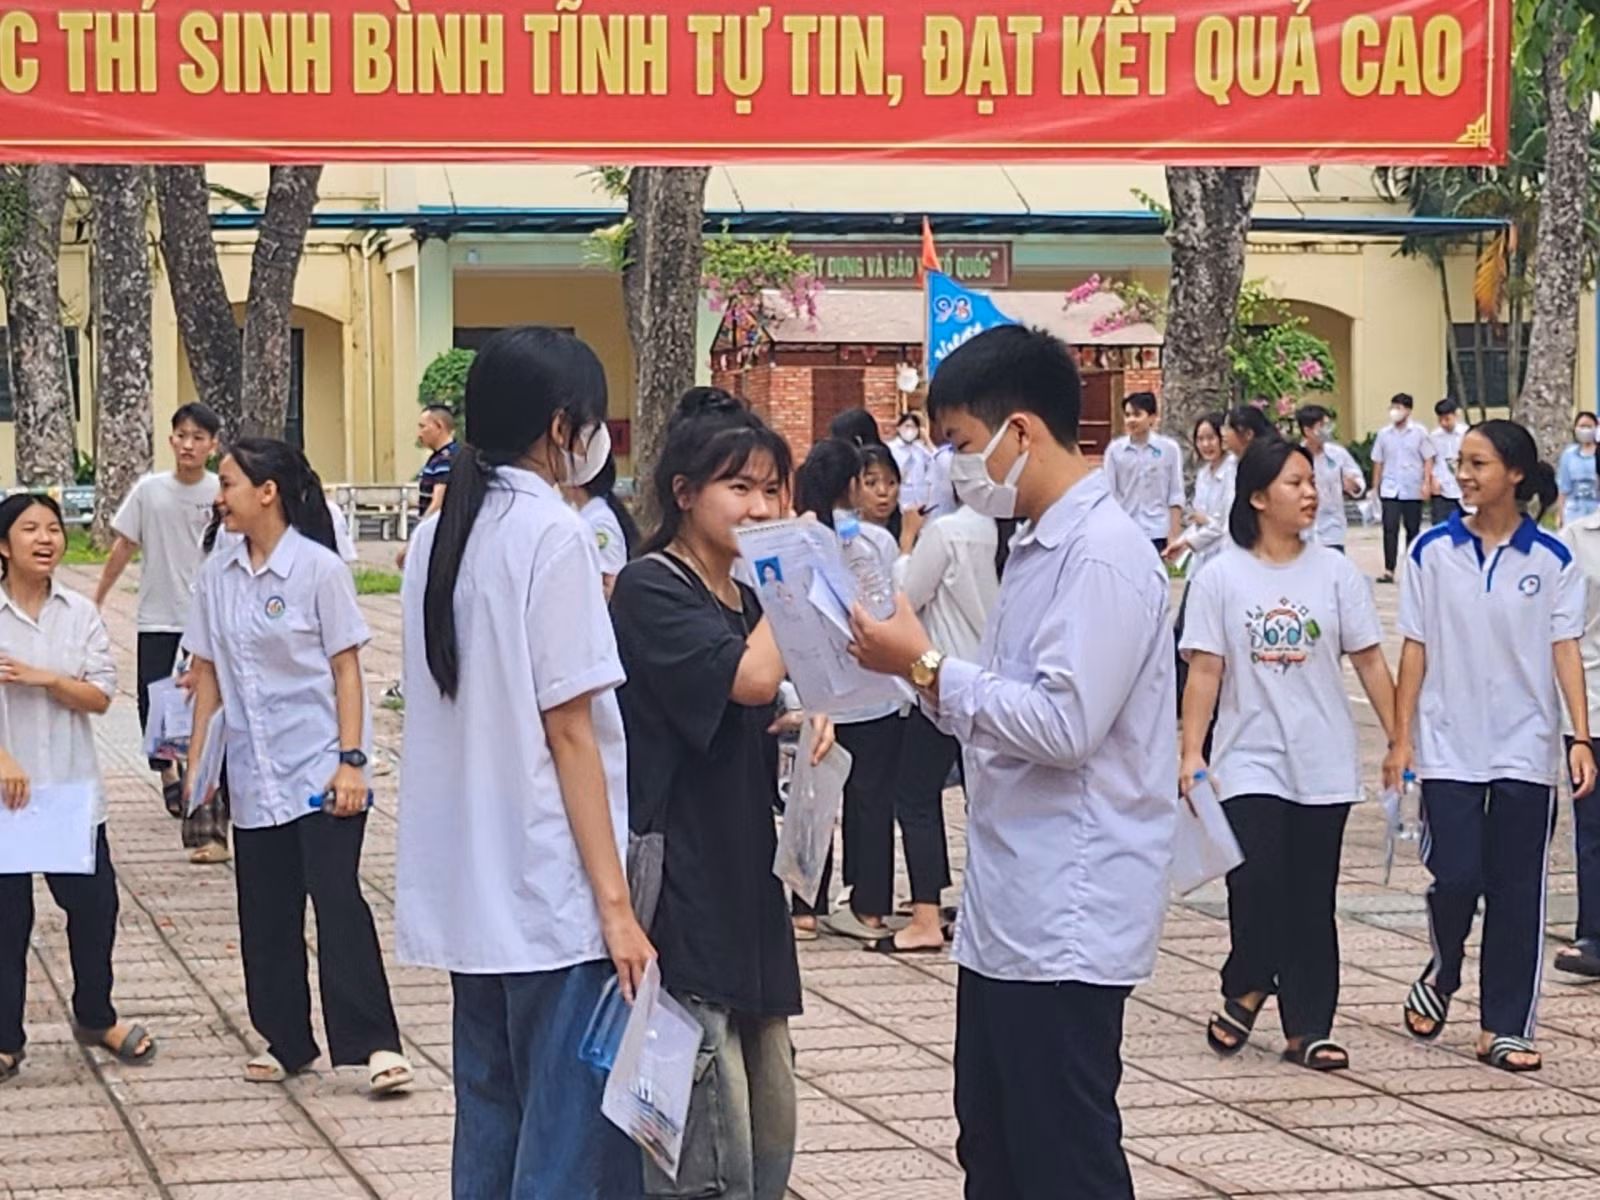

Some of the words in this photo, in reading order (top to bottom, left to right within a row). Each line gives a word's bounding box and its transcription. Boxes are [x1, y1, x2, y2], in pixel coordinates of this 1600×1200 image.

[0, 10, 39, 94] C
[58, 0, 158, 93] THÍ
[179, 10, 332, 94] SINH
[352, 0, 505, 94] BÌNH
[524, 0, 668, 95] TĨNH
[687, 5, 772, 114] TỰ
[783, 15, 904, 107] TIN,
[922, 15, 1043, 114] ĐẠT
[1061, 0, 1176, 96] KẾT
[1340, 13, 1463, 97] CAO
